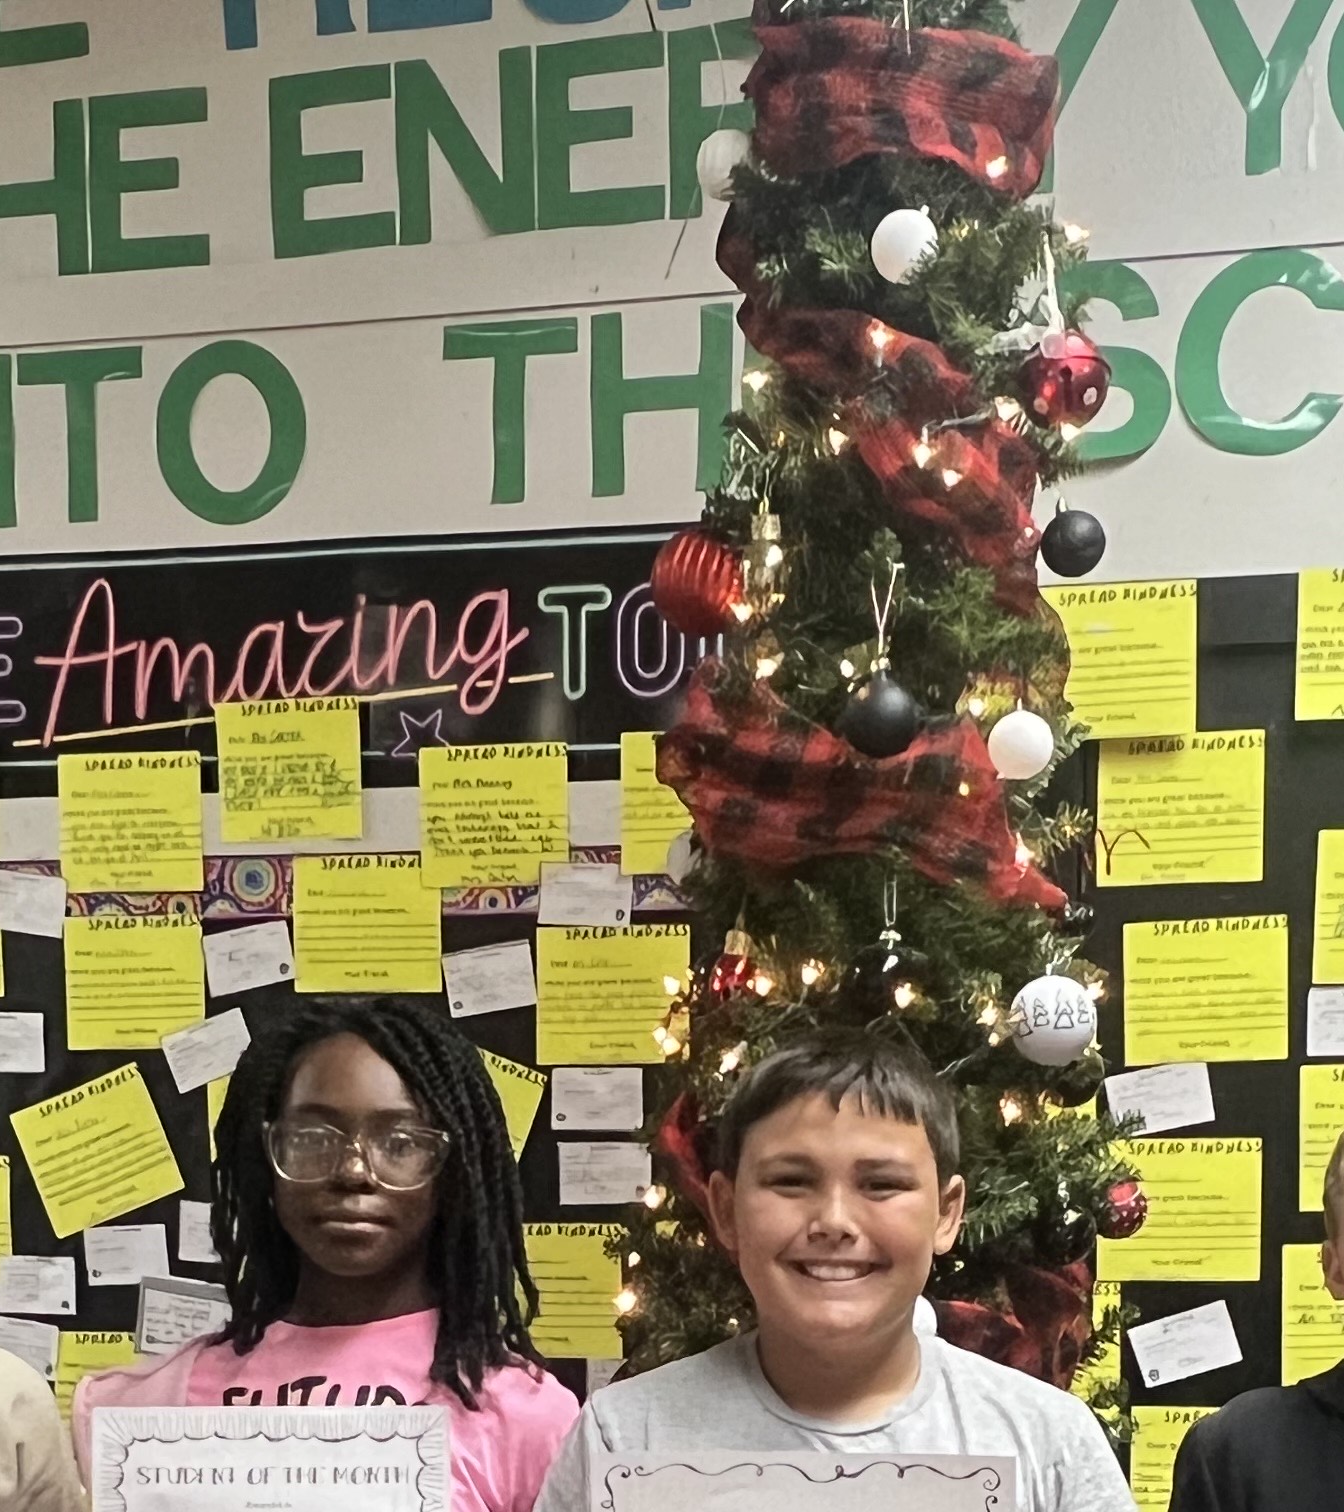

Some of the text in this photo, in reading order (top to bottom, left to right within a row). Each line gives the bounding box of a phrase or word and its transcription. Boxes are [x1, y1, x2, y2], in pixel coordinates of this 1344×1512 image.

[268, 12, 760, 259] ENER
[443, 302, 738, 505] TH
[33, 578, 530, 748] Amazing
[1058, 589, 1117, 607] SPREAD
